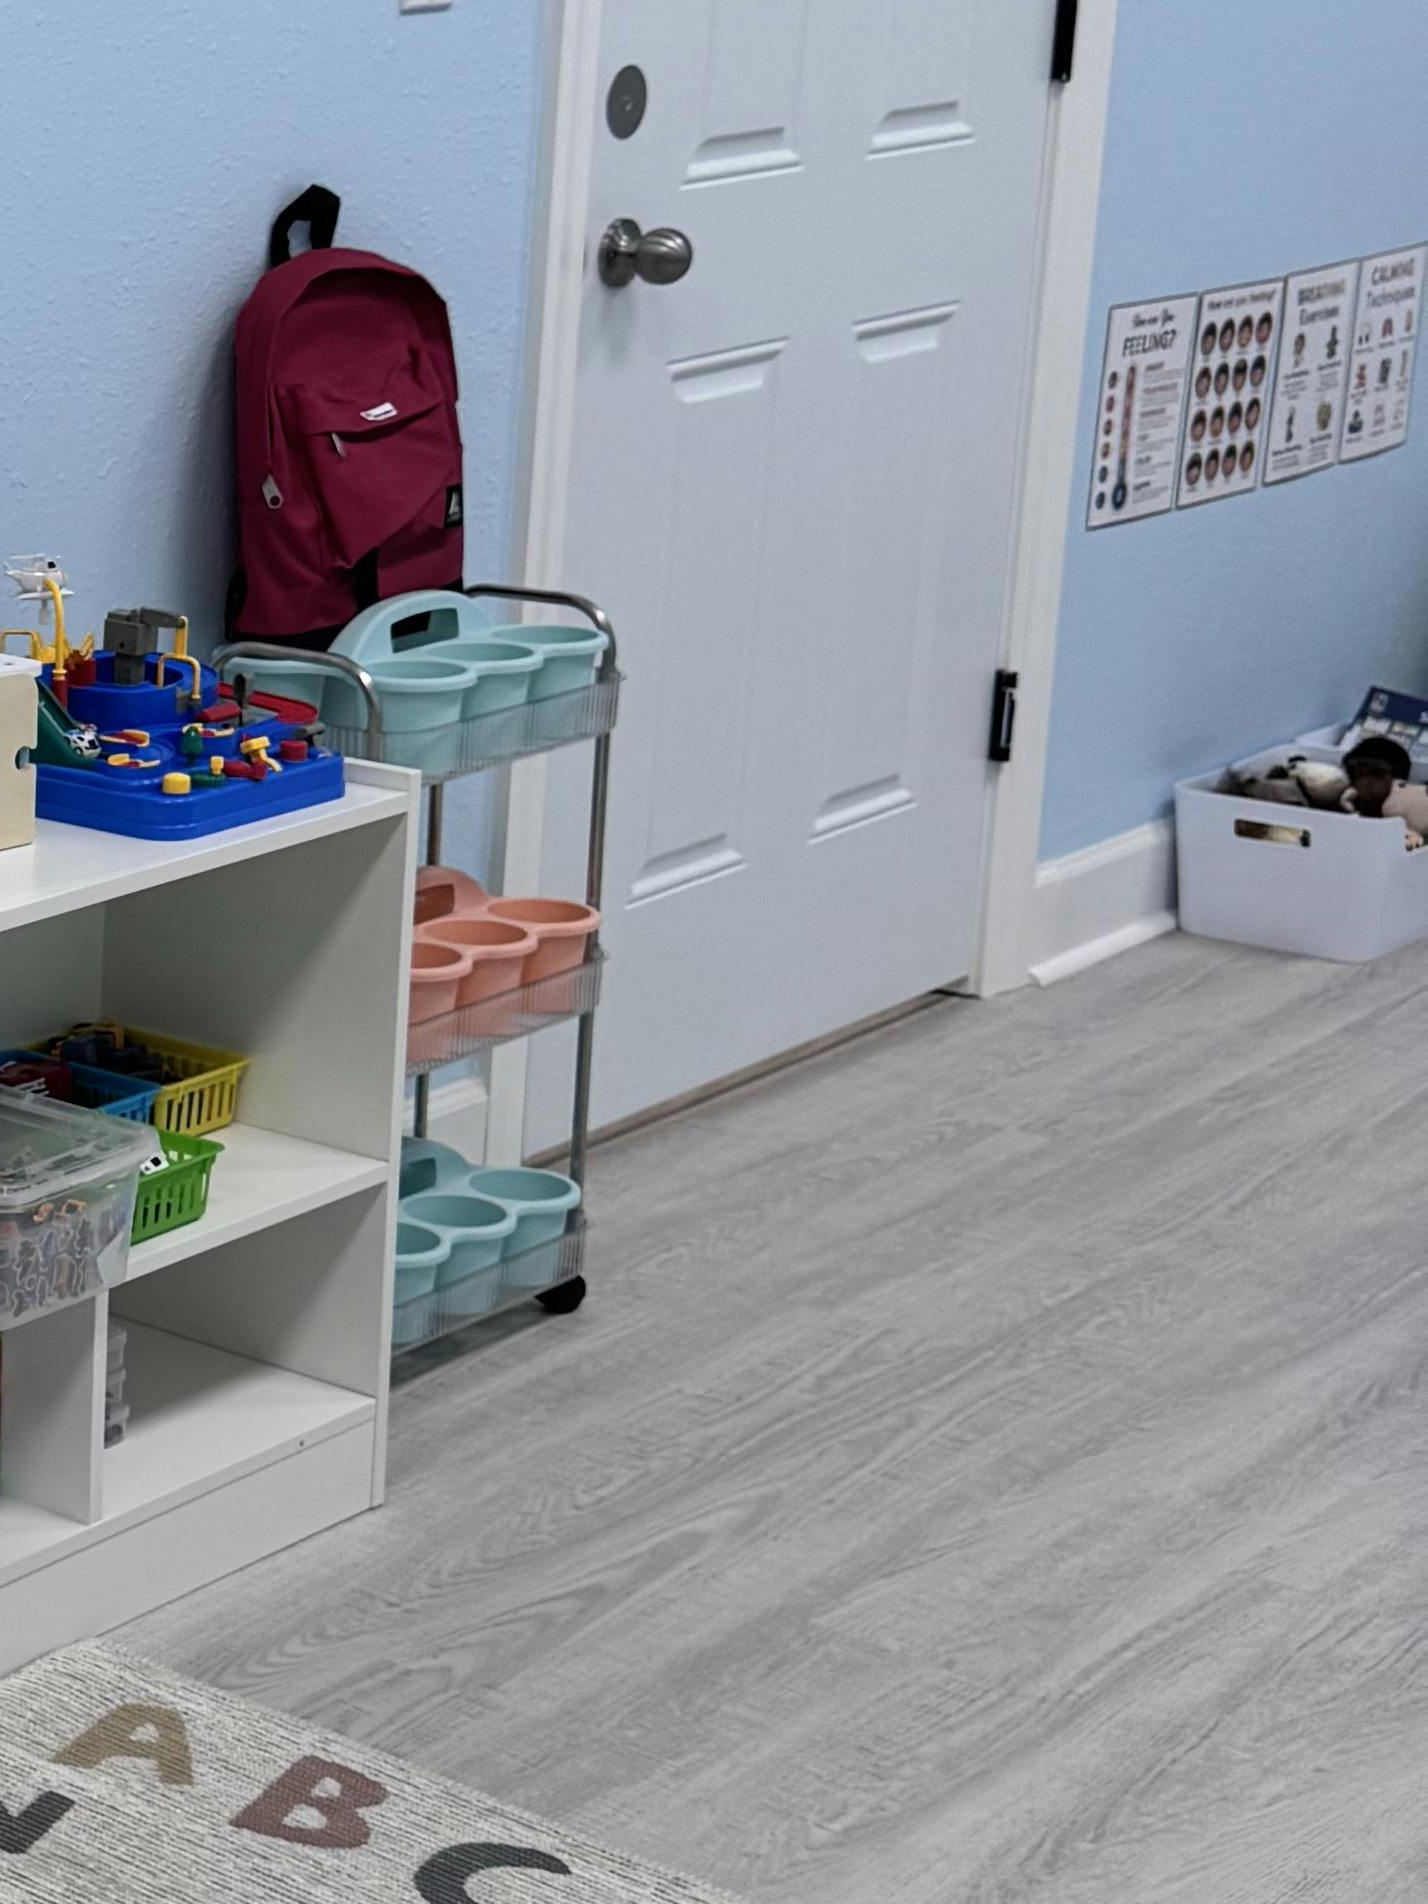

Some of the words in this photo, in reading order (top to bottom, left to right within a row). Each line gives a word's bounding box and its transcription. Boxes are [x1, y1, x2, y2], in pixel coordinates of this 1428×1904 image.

[1123, 328, 1178, 357] FEELING?
[51, 1701, 196, 1787] A
[229, 1753, 391, 1851] B
